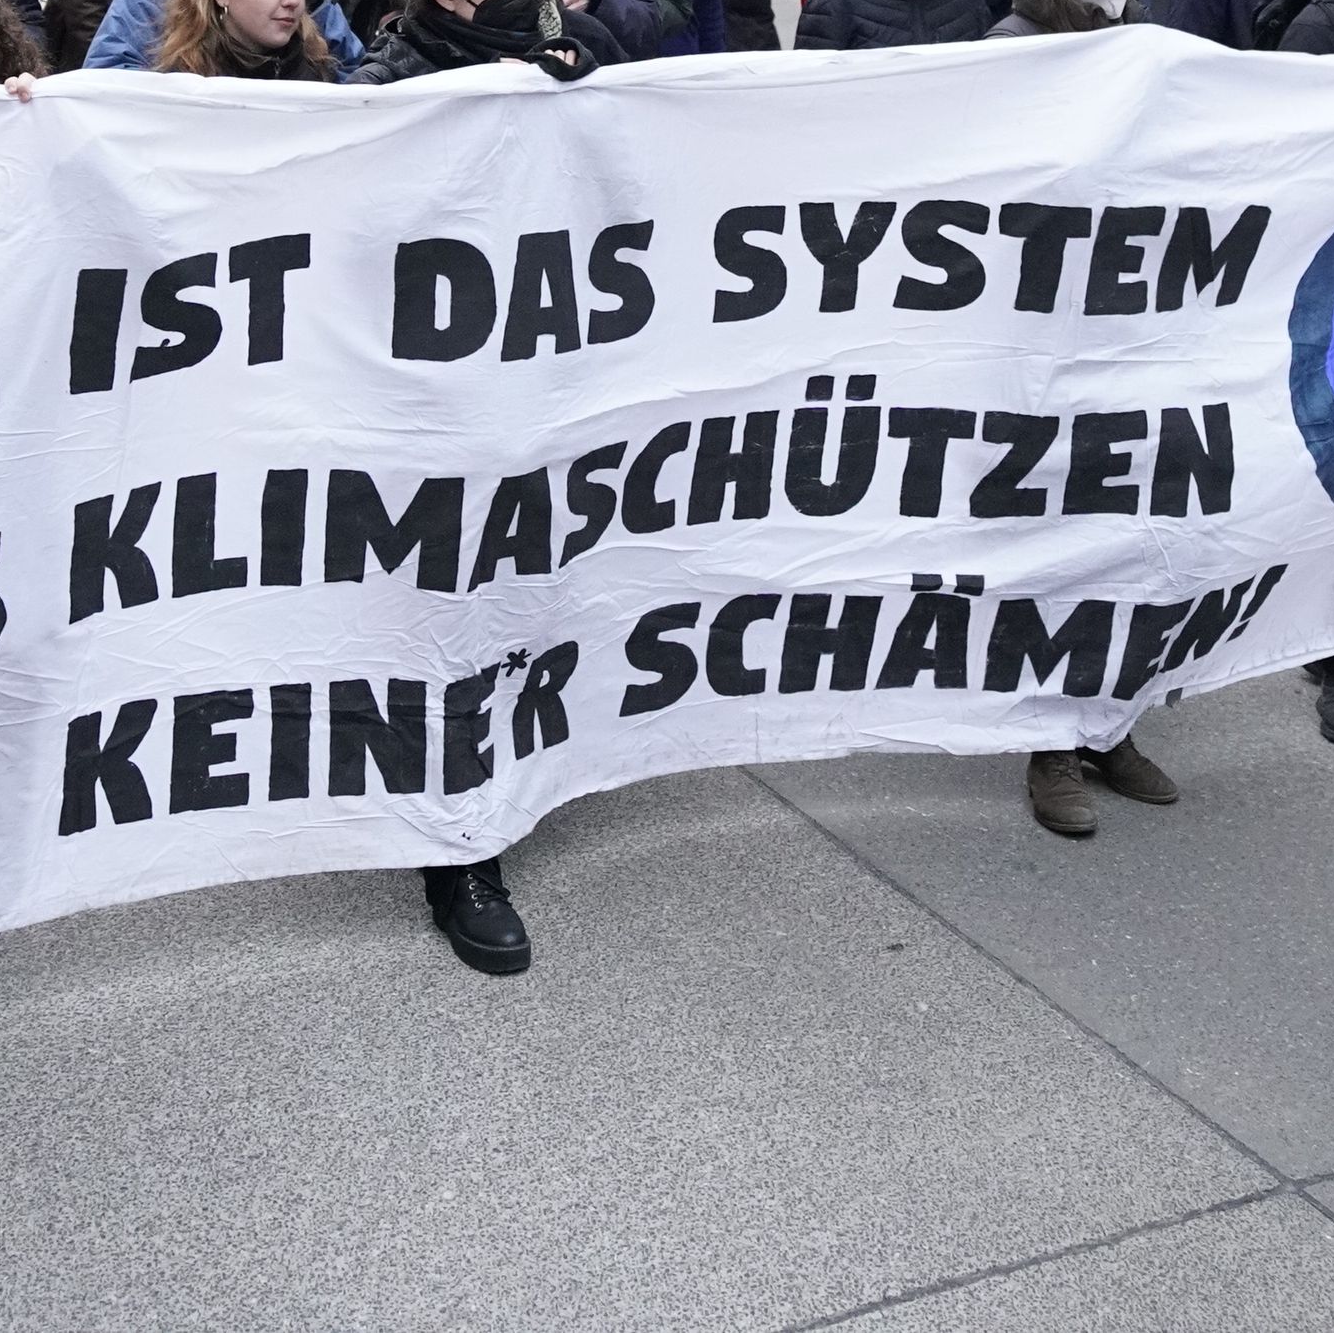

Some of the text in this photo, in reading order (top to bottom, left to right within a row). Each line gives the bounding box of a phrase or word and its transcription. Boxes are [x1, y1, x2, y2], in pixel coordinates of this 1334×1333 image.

[70, 234, 310, 394] IST
[392, 220, 654, 362] DAS
[713, 200, 1271, 322] SYSTEM
[69, 375, 1234, 624] KLIMASCHÜTZEN
[619, 564, 1288, 717] SCHÄMEN!
